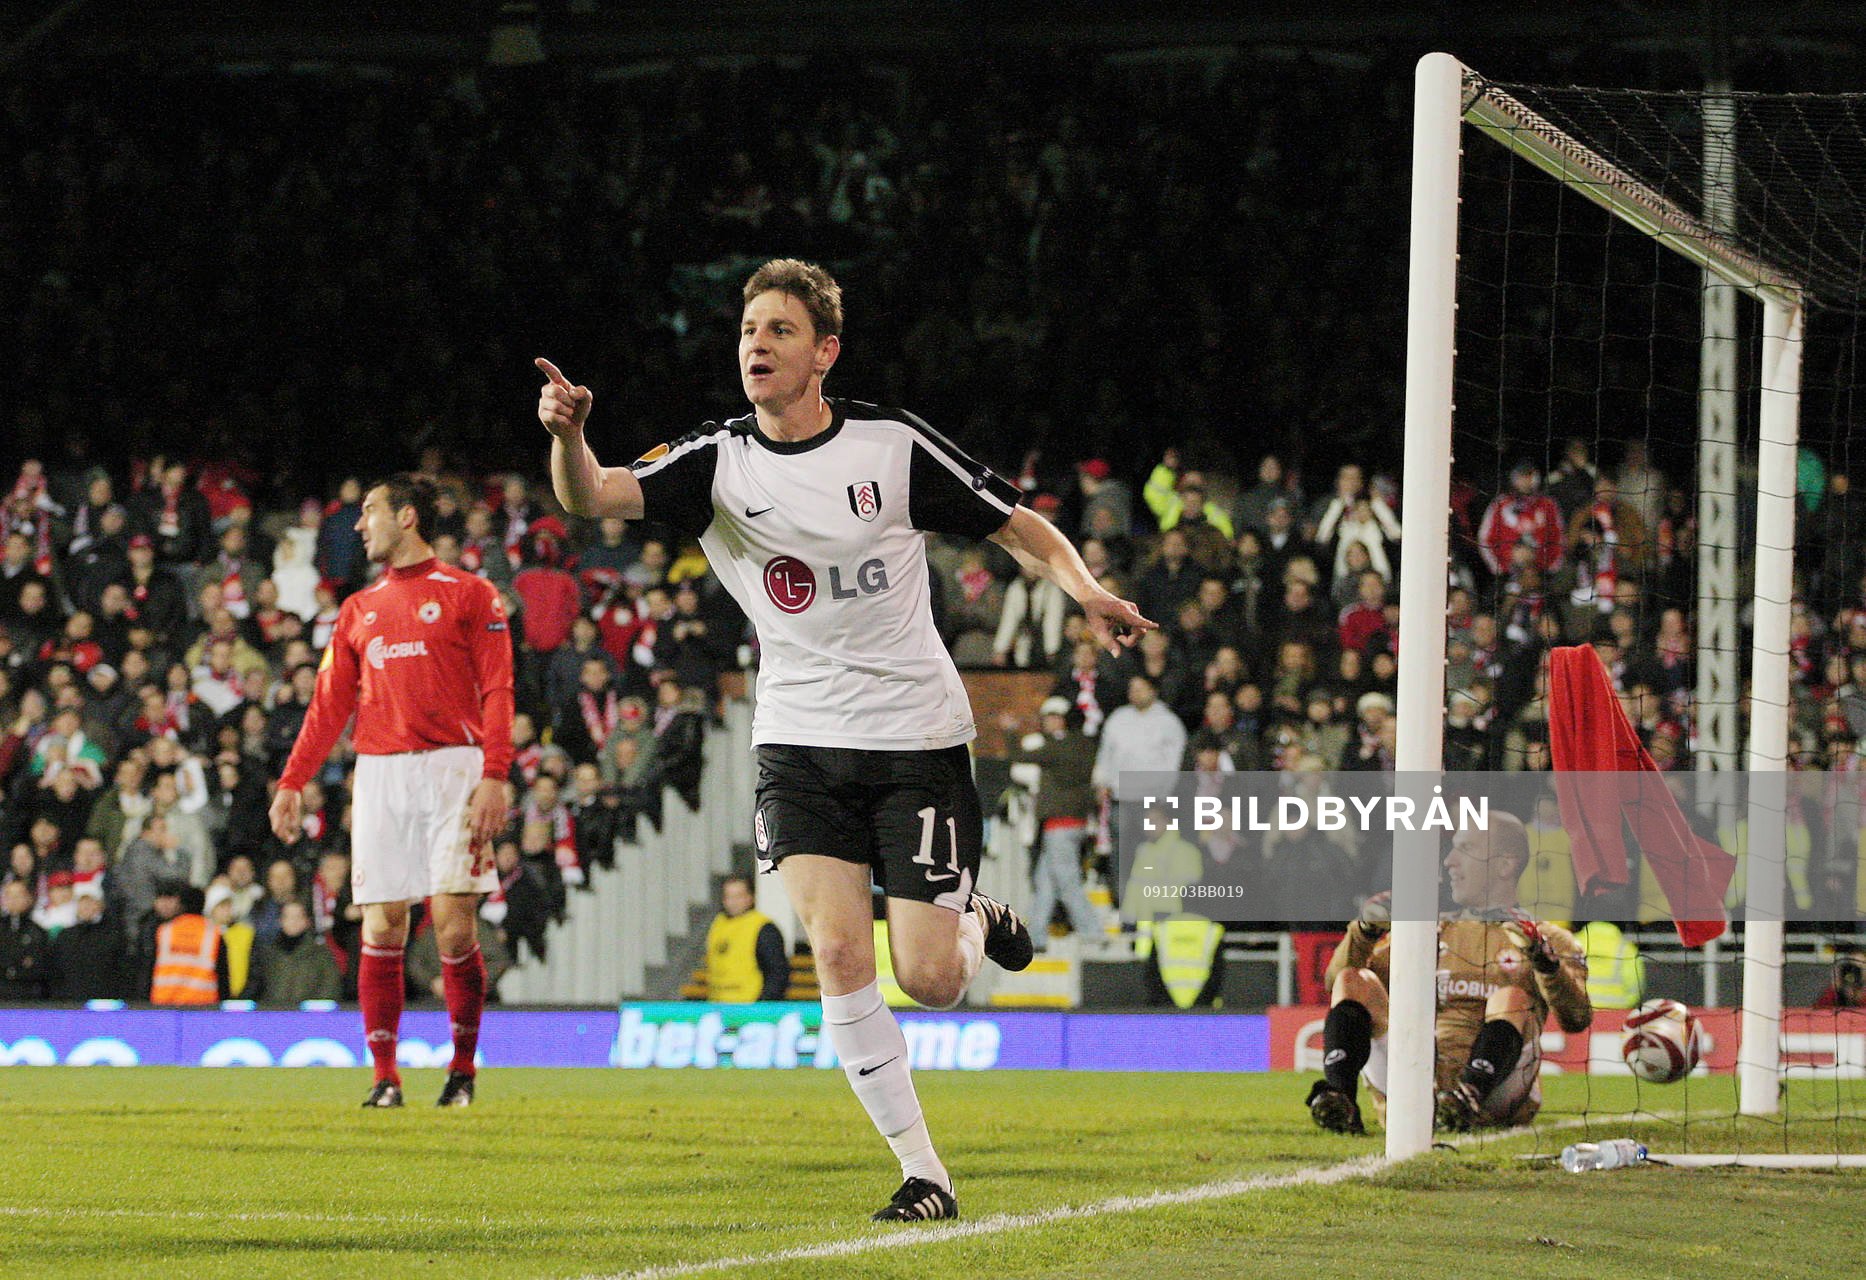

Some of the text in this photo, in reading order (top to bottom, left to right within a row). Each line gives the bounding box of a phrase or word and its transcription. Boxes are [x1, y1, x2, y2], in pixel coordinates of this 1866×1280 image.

[828, 558, 890, 600] LG
[366, 636, 428, 670] GLOBUL
[912, 806, 960, 874] 11
[612, 1007, 1000, 1070] bet-at-me
